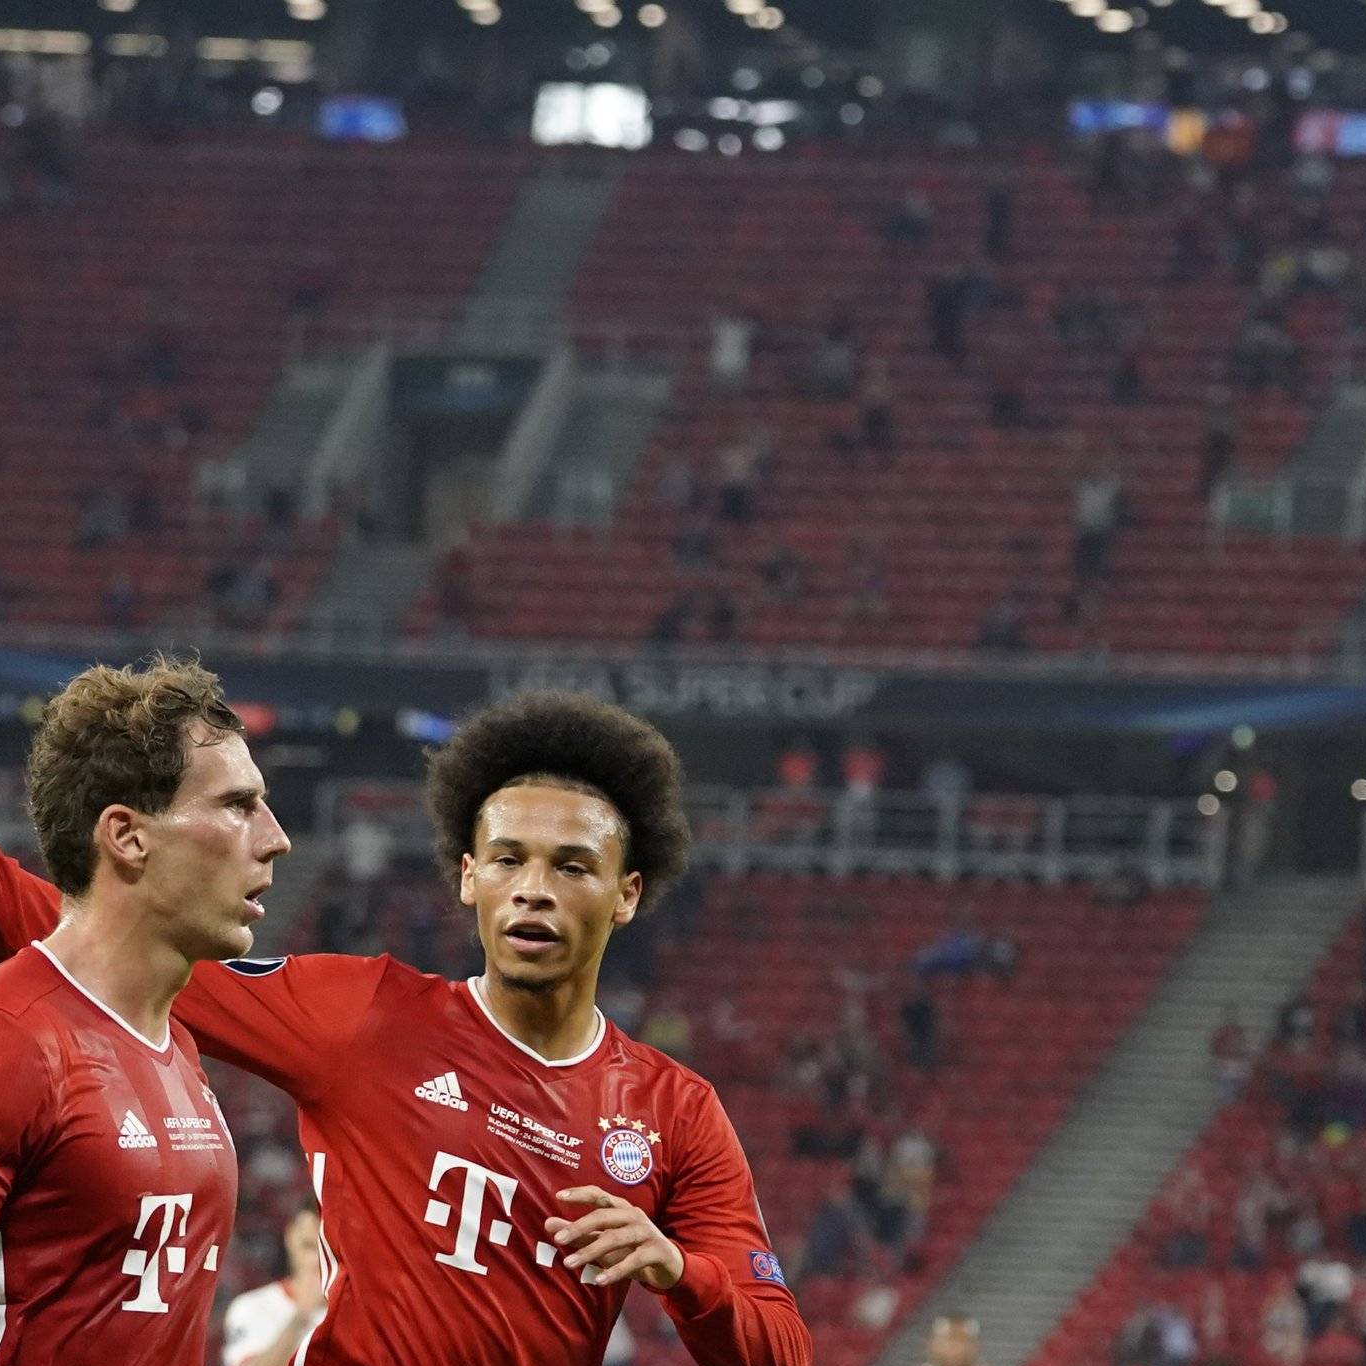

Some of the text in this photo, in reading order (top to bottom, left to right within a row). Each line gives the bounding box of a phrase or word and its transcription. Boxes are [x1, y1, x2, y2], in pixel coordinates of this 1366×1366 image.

[414, 1085, 469, 1112] adidas
[488, 1116, 519, 1135] BUDAPEST
[531, 1135, 565, 1155] SEPTEMBER
[565, 1150, 581, 1160] 2020
[491, 1103, 520, 1124] UEFA
[522, 1117, 556, 1140] SUPER
[495, 1128, 515, 1143] BAYERN
[515, 1139, 544, 1156] MÜNCHEN
[550, 1153, 571, 1167] SEVILLA
[607, 1133, 650, 1158] FC BAYERN
